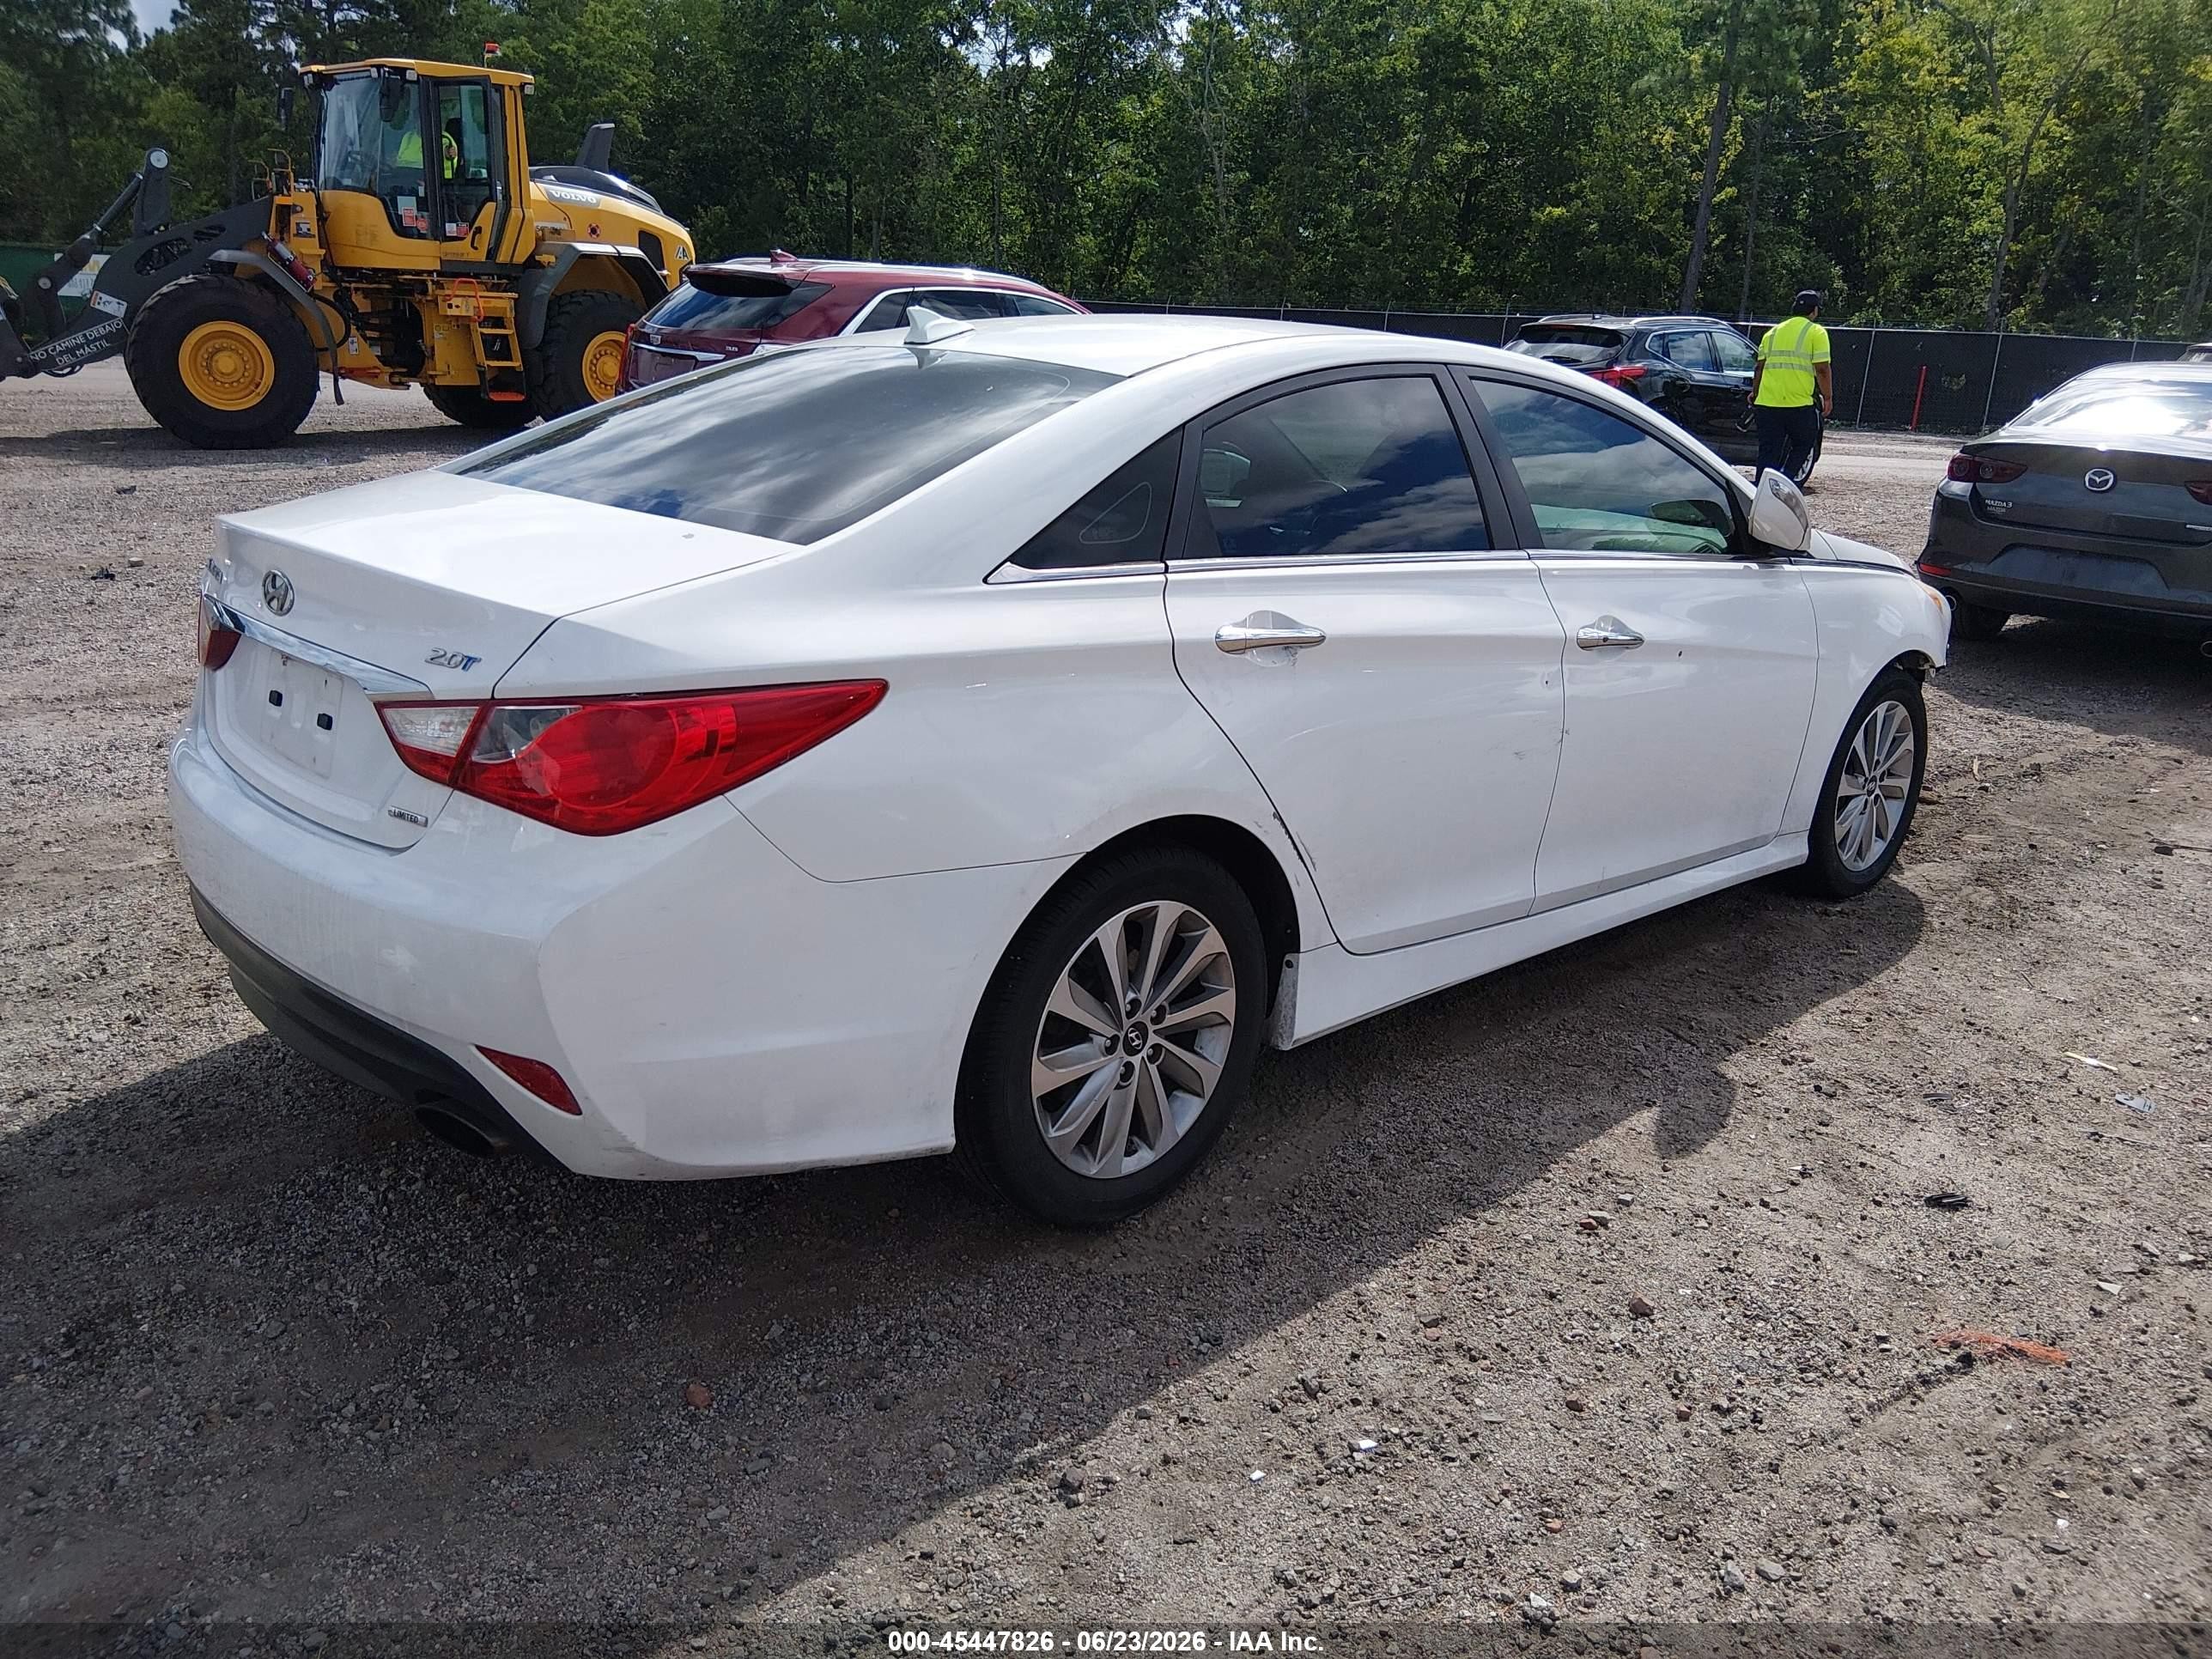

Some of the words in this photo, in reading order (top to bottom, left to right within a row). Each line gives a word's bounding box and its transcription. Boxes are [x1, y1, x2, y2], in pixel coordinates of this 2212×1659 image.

[550, 190, 597, 204] VOLVO
[29, 350, 47, 361] NO
[48, 335, 86, 355] CAMINE
[86, 321, 123, 340] DEBAJO
[56, 353, 76, 365] DEL
